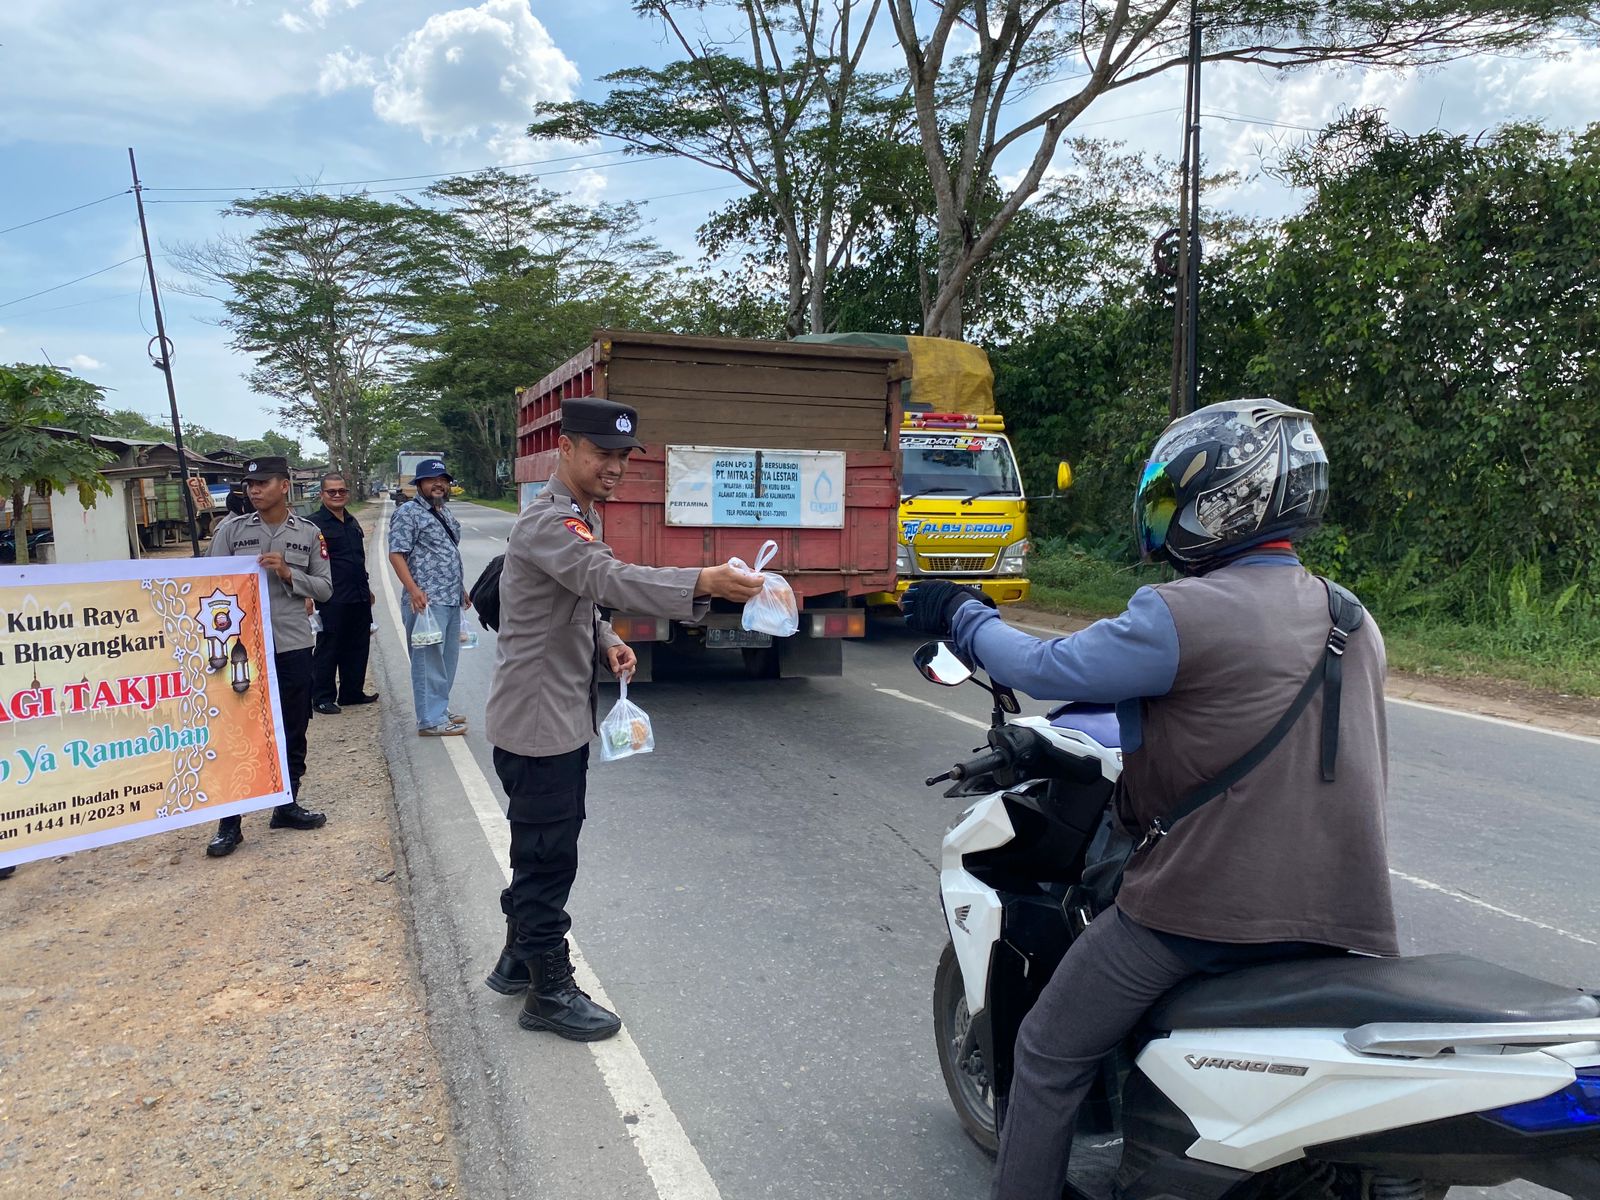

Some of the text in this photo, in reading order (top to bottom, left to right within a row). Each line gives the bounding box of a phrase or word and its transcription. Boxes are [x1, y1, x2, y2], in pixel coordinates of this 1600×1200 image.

[716, 460, 733, 468] AGEN
[716, 470, 725, 480] PT.
[727, 470, 748, 480] MITRA
[773, 472, 798, 482] LESTARI
[922, 524, 1013, 534] ALBY GROUP
[286, 542, 311, 553] POLRI
[8, 606, 140, 633] Kubu Raya
[708, 629, 721, 641] KB
[14, 630, 165, 664] Bhayangkari
[64, 671, 192, 712] TAKJIL
[16, 745, 57, 785] Ya
[64, 725, 209, 769] Ramadhan
[72, 788, 119, 808] Ibadah
[124, 781, 164, 798] Puasa
[26, 816, 64, 834] 1444
[70, 804, 125, 827] H/2023
[130, 800, 141, 812] M
[1184, 1054, 1270, 1073] VARIO
